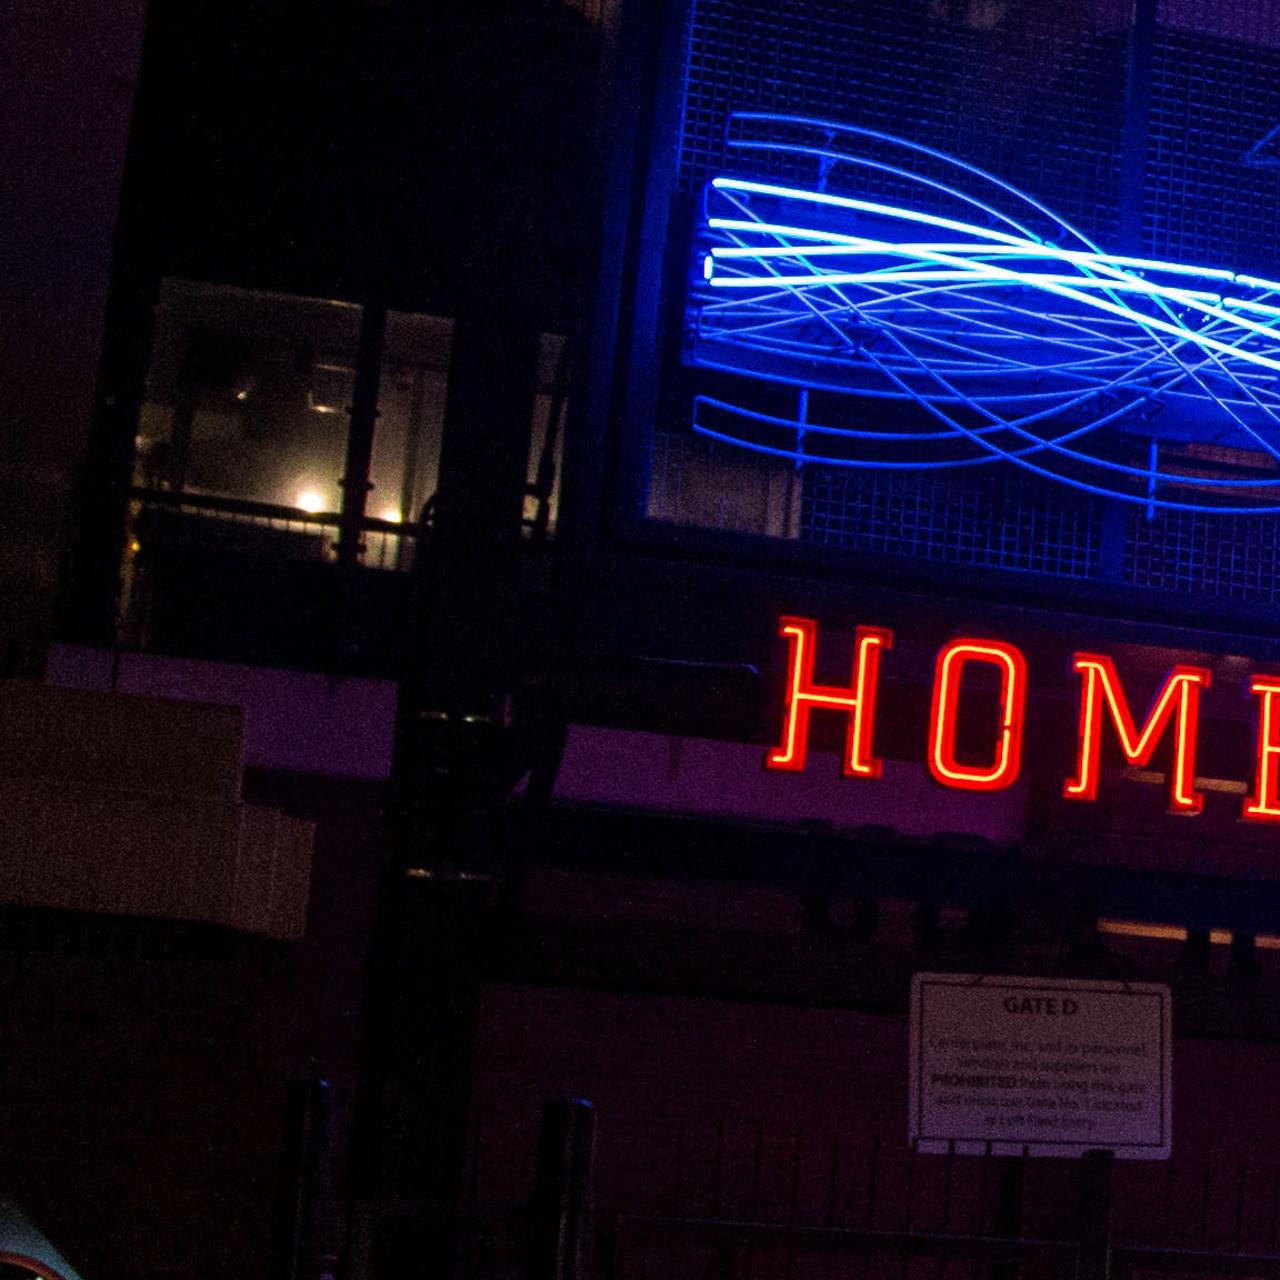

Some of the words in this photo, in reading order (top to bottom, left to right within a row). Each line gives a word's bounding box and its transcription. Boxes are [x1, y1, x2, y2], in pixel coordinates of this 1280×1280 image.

[1003, 996, 1057, 1015] GATE
[1062, 998, 1078, 1016] D
[931, 1073, 1016, 1088] PROHIBITED
